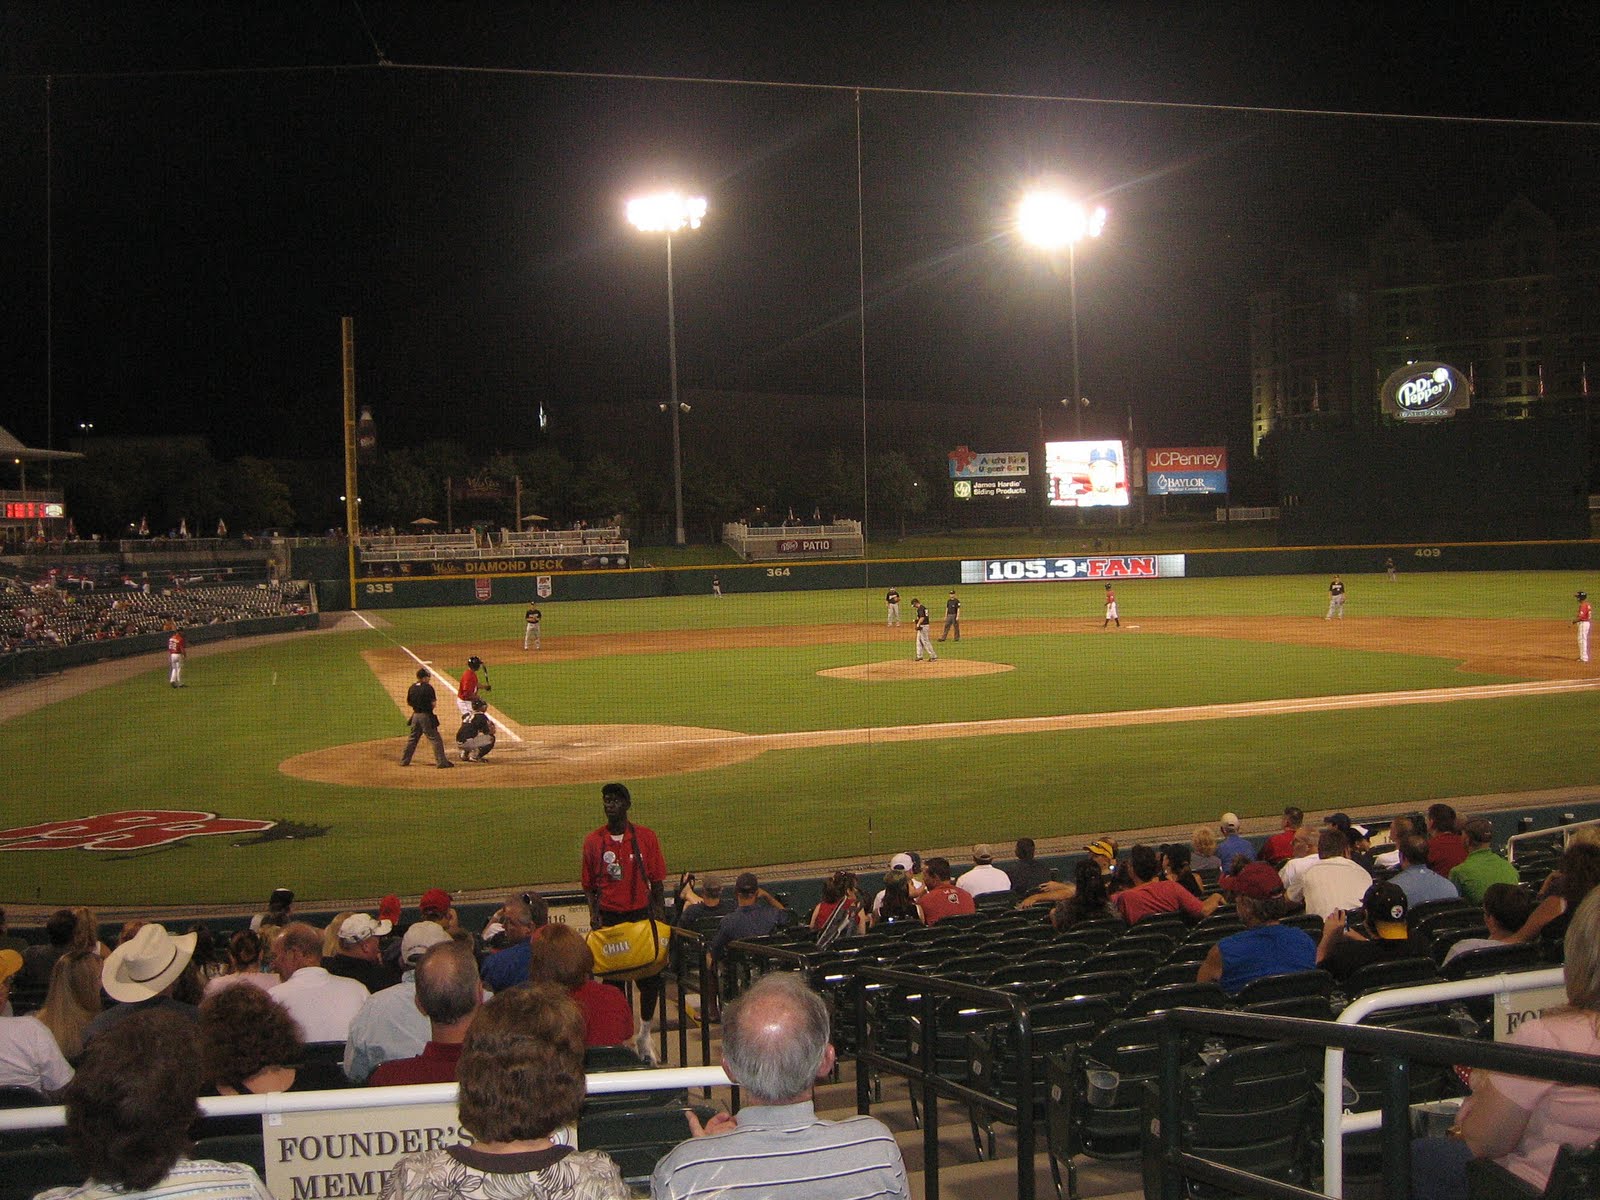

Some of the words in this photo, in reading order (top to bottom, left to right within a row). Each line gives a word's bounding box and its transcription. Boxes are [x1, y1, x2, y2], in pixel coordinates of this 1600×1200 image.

[1416, 378, 1433, 391] Dr
[1399, 382, 1445, 407] Pepper
[1150, 451, 1223, 468] JCPenney
[973, 481, 996, 489] James
[1168, 477, 1205, 487] BAYLOR
[973, 488, 995, 496] Siding
[996, 487, 1027, 495] Products
[803, 540, 830, 550] PATIO
[1414, 548, 1441, 557] 409
[465, 560, 527, 573] DIAMOND
[530, 559, 564, 571] DECK
[989, 559, 1077, 580] 105.3
[1087, 557, 1154, 577] FAN
[766, 567, 791, 577] 364
[366, 583, 394, 593] 335
